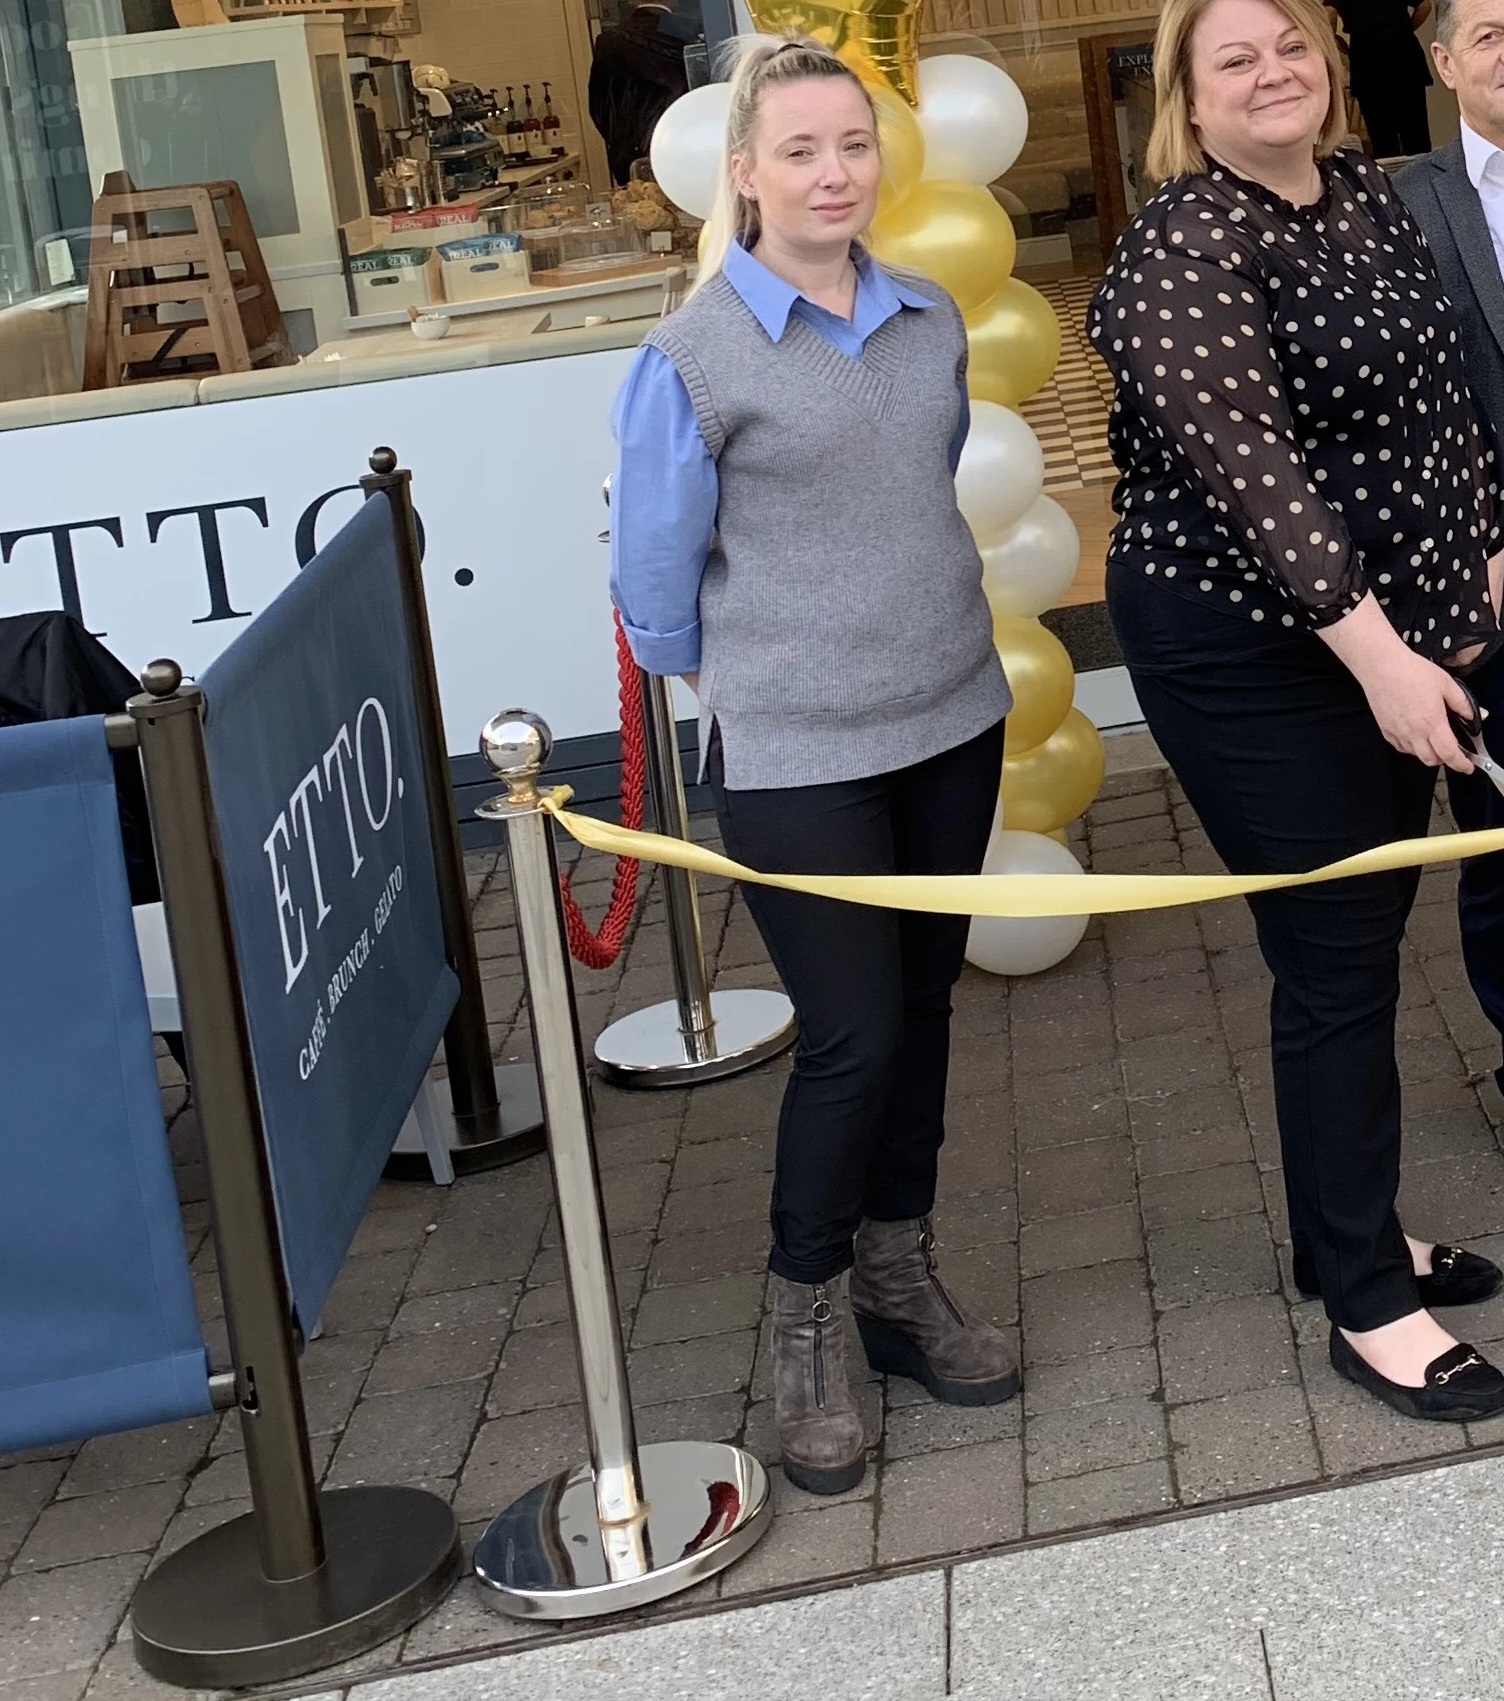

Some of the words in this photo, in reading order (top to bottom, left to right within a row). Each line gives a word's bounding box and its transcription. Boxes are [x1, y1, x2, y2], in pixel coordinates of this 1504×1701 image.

[263, 697, 404, 995] ETTO.
[327, 927, 370, 1014] BRUNCH
[374, 865, 403, 935] GELATO
